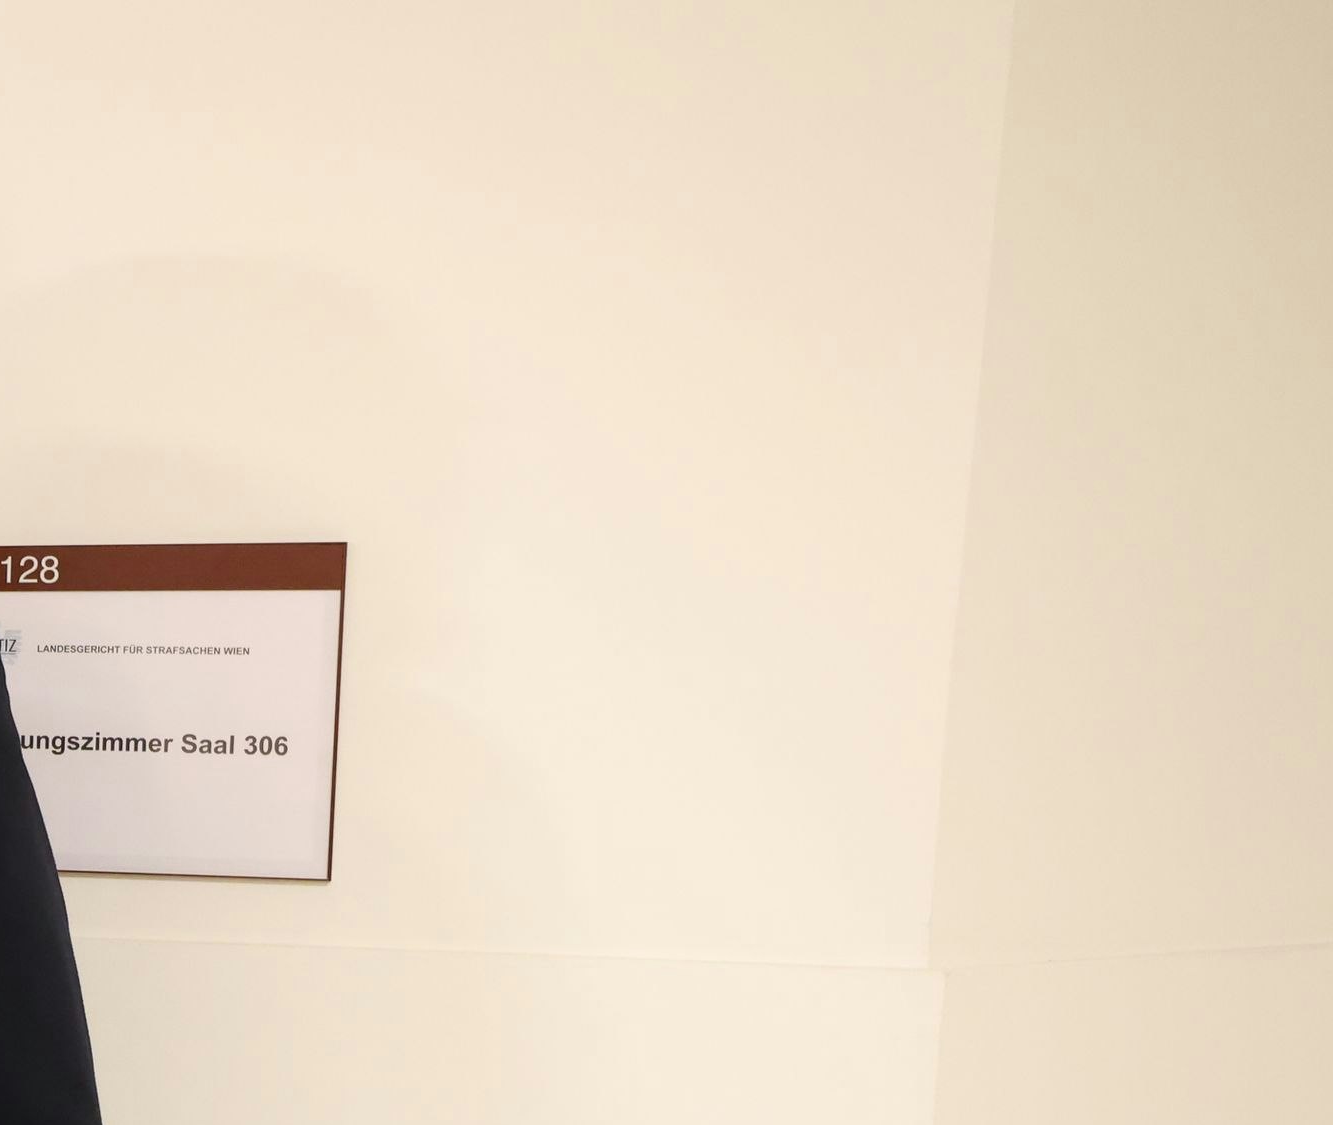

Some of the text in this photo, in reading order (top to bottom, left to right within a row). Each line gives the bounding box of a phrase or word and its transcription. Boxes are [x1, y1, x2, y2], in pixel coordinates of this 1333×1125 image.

[36, 643, 250, 656] LANDESGERICHT FÜR STRAFSACHEN WIEN
[20, 731, 288, 756] ungszimmer Saal 306
